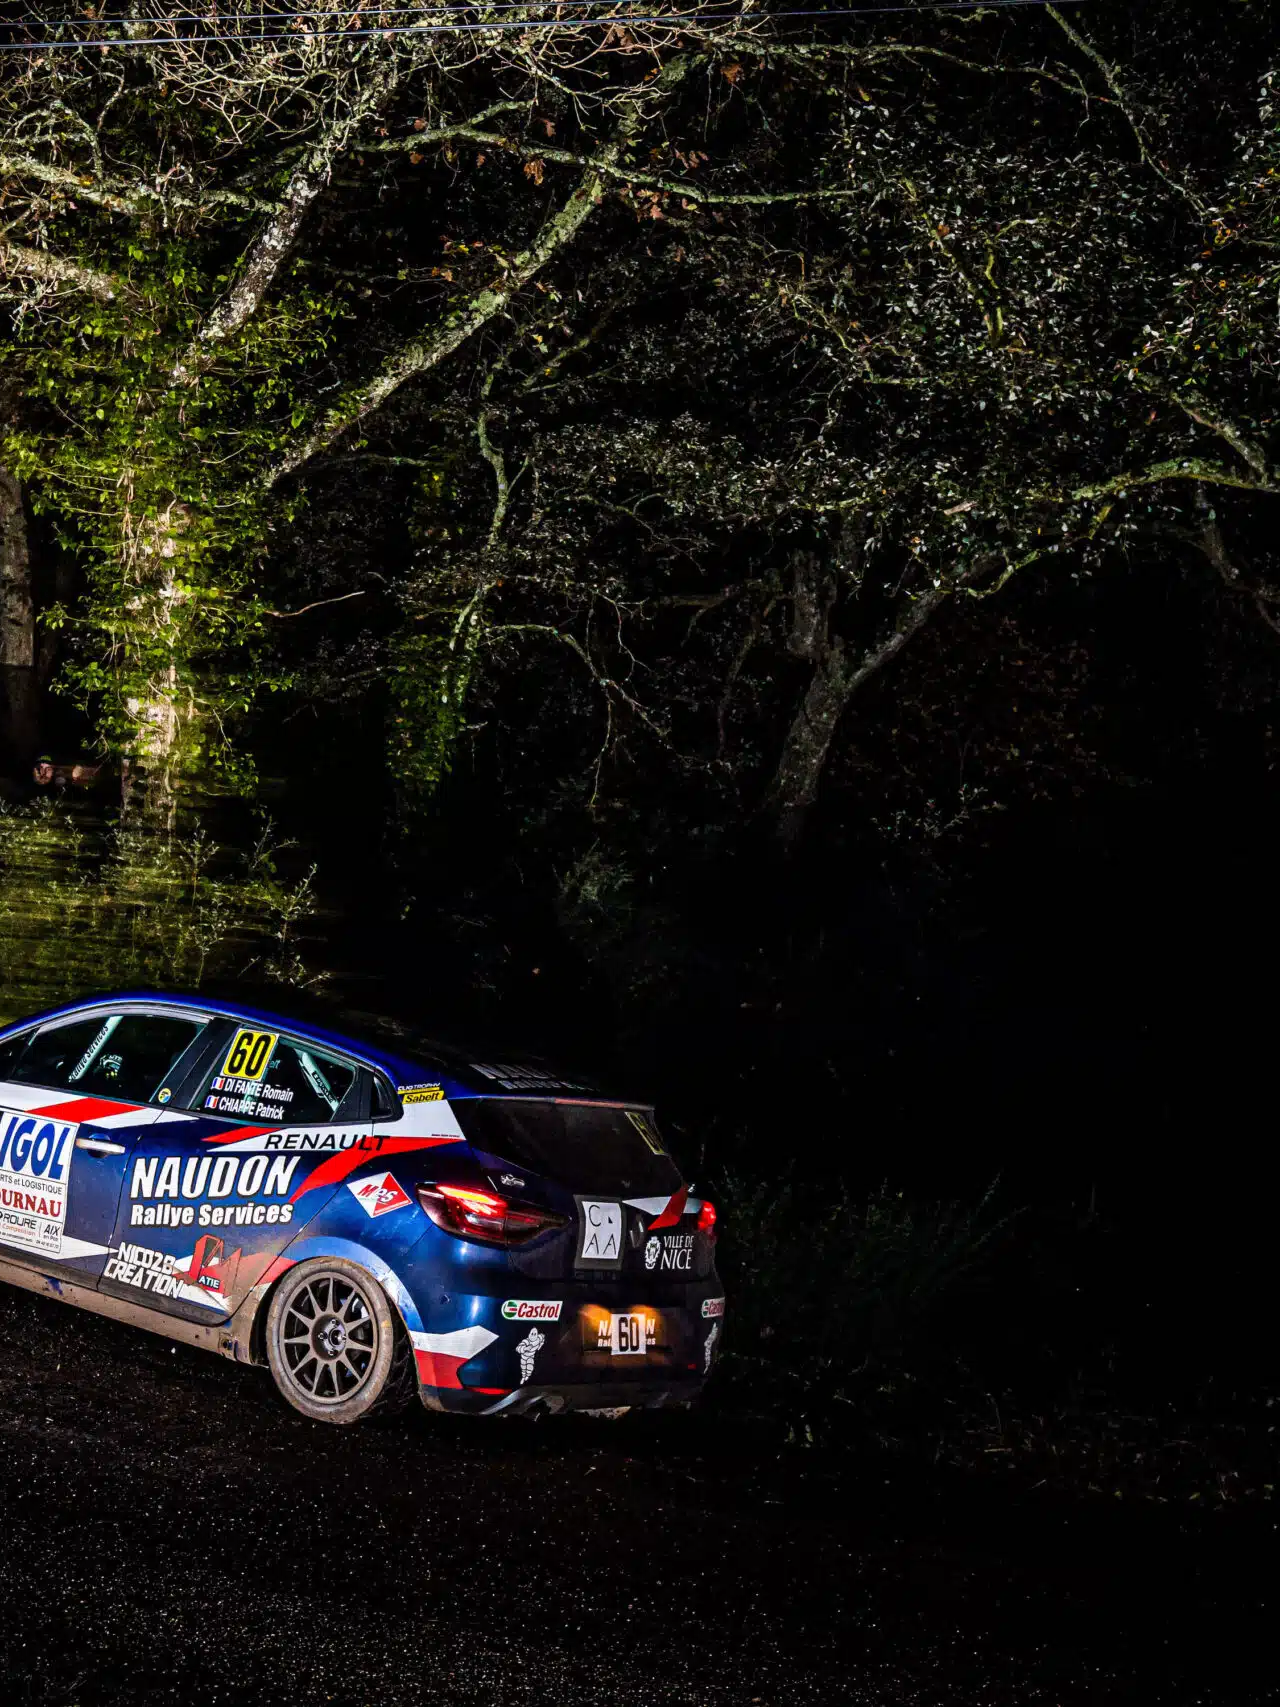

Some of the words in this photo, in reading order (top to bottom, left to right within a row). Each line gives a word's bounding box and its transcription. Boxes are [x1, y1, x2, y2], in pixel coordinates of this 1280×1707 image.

[227, 1032, 271, 1077] 60
[224, 1078, 234, 1091] DI
[234, 1080, 261, 1095] FANTE
[261, 1084, 294, 1102] Romain
[405, 1092, 440, 1103] Sabelt
[218, 1097, 256, 1115] CHIAPPE
[256, 1102, 285, 1120] Patrick
[263, 1133, 391, 1151] RENAULT
[13, 1178, 21, 1186] et
[21, 1180, 63, 1195] LOGISTIQUE
[130, 1155, 302, 1199] NAUDON
[3, 1211, 38, 1230] ROURE
[130, 1203, 195, 1227] Rallye
[198, 1202, 294, 1227] Services
[588, 1204, 602, 1227] C
[43, 1223, 61, 1236] AIX
[585, 1233, 600, 1255] A
[603, 1233, 617, 1255] A
[663, 1235, 684, 1248] VILLE
[684, 1235, 694, 1248] DE
[117, 1241, 177, 1276] NICO2B
[660, 1248, 693, 1270] NICE
[103, 1258, 184, 1299] CREATION
[517, 1303, 560, 1319] Castrol
[618, 1316, 640, 1352] 60
